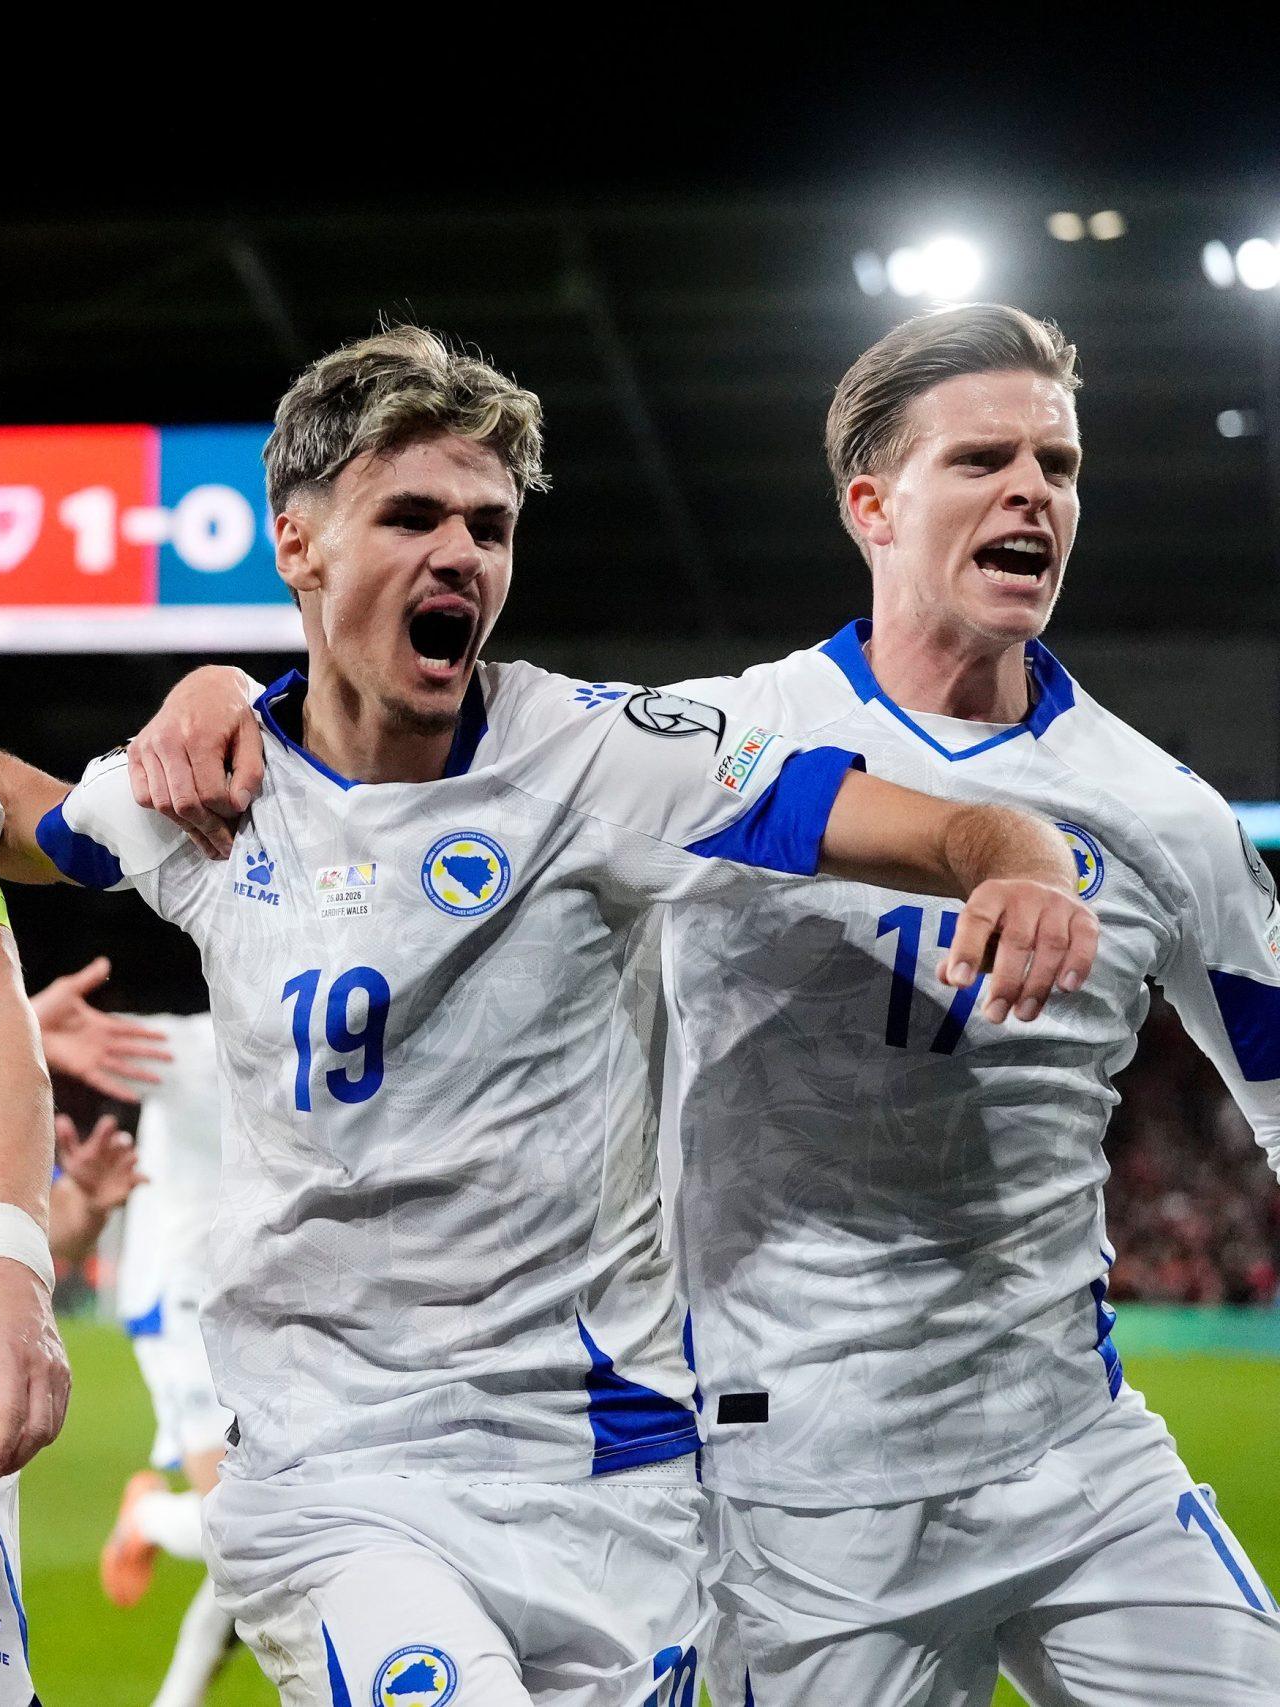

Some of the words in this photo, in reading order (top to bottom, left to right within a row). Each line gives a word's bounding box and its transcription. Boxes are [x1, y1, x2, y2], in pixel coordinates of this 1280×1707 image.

[58, 484, 256, 574] 1-0
[715, 755, 734, 782] UEFA
[346, 905, 368, 916] WALES
[280, 966, 391, 1113] 19
